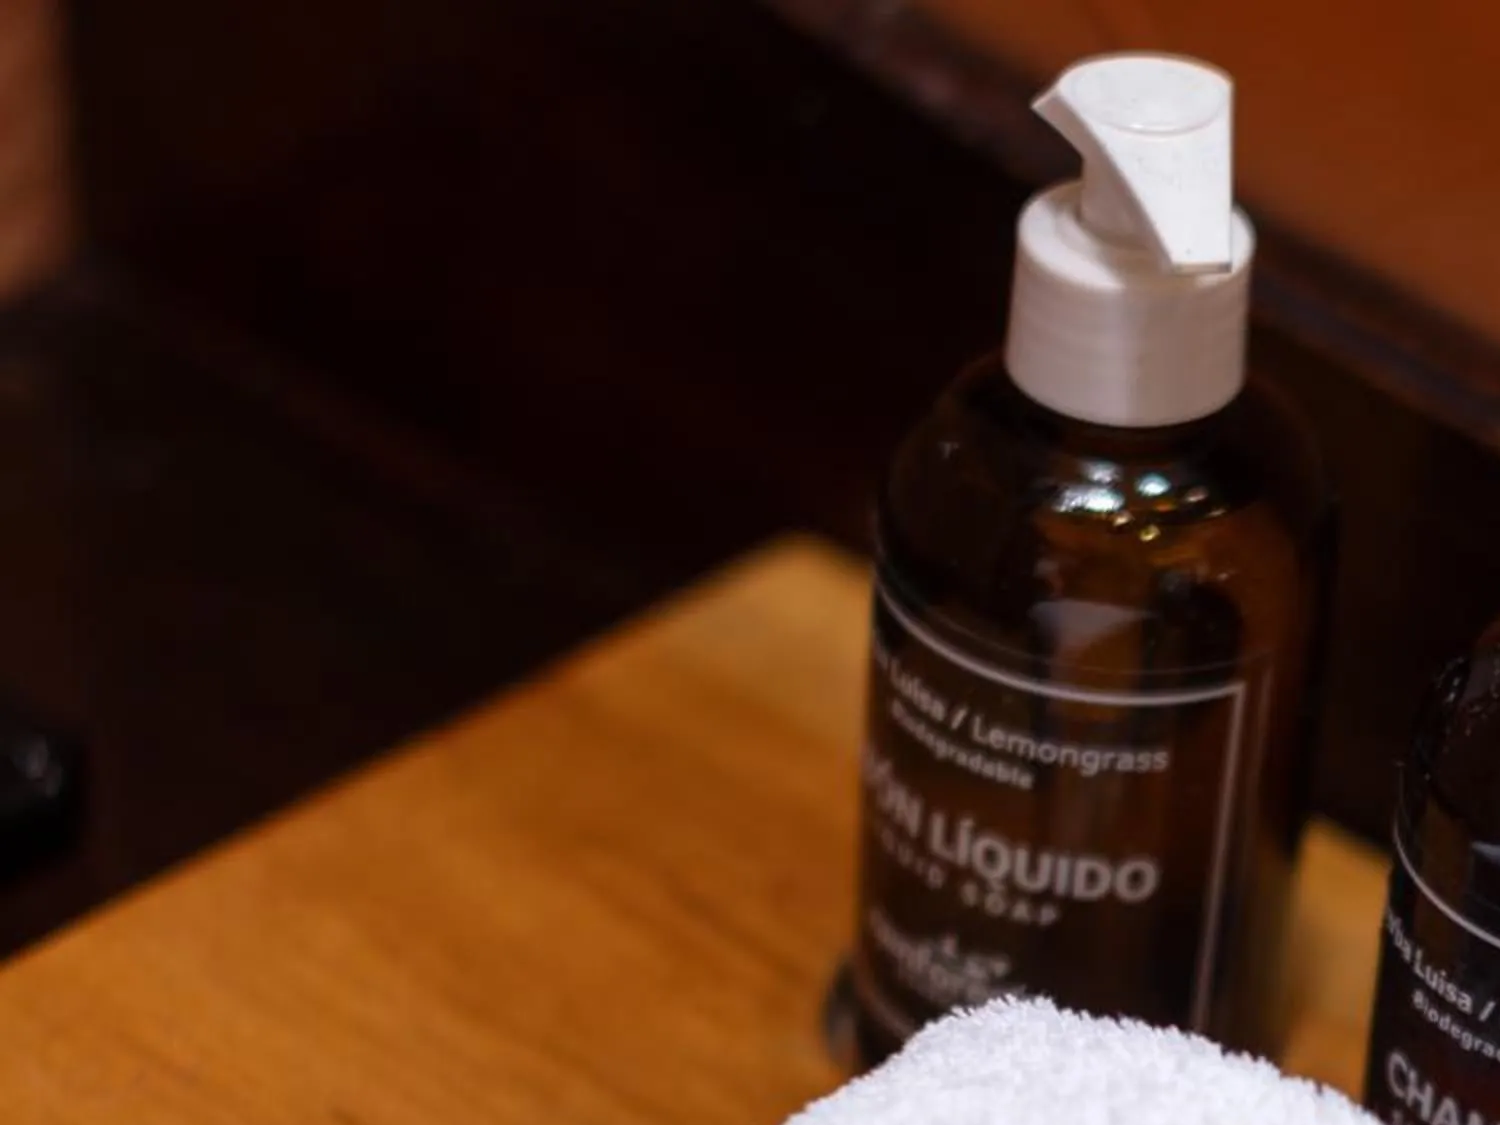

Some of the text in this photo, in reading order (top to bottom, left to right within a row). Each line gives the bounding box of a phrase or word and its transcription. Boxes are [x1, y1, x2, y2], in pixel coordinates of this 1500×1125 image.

[951, 706, 969, 730] /
[971, 713, 1170, 777] Lemongrass
[930, 812, 1158, 901] LÍQUIDO
[1413, 948, 1474, 1016] Luisa
[1478, 1000, 1496, 1022] /
